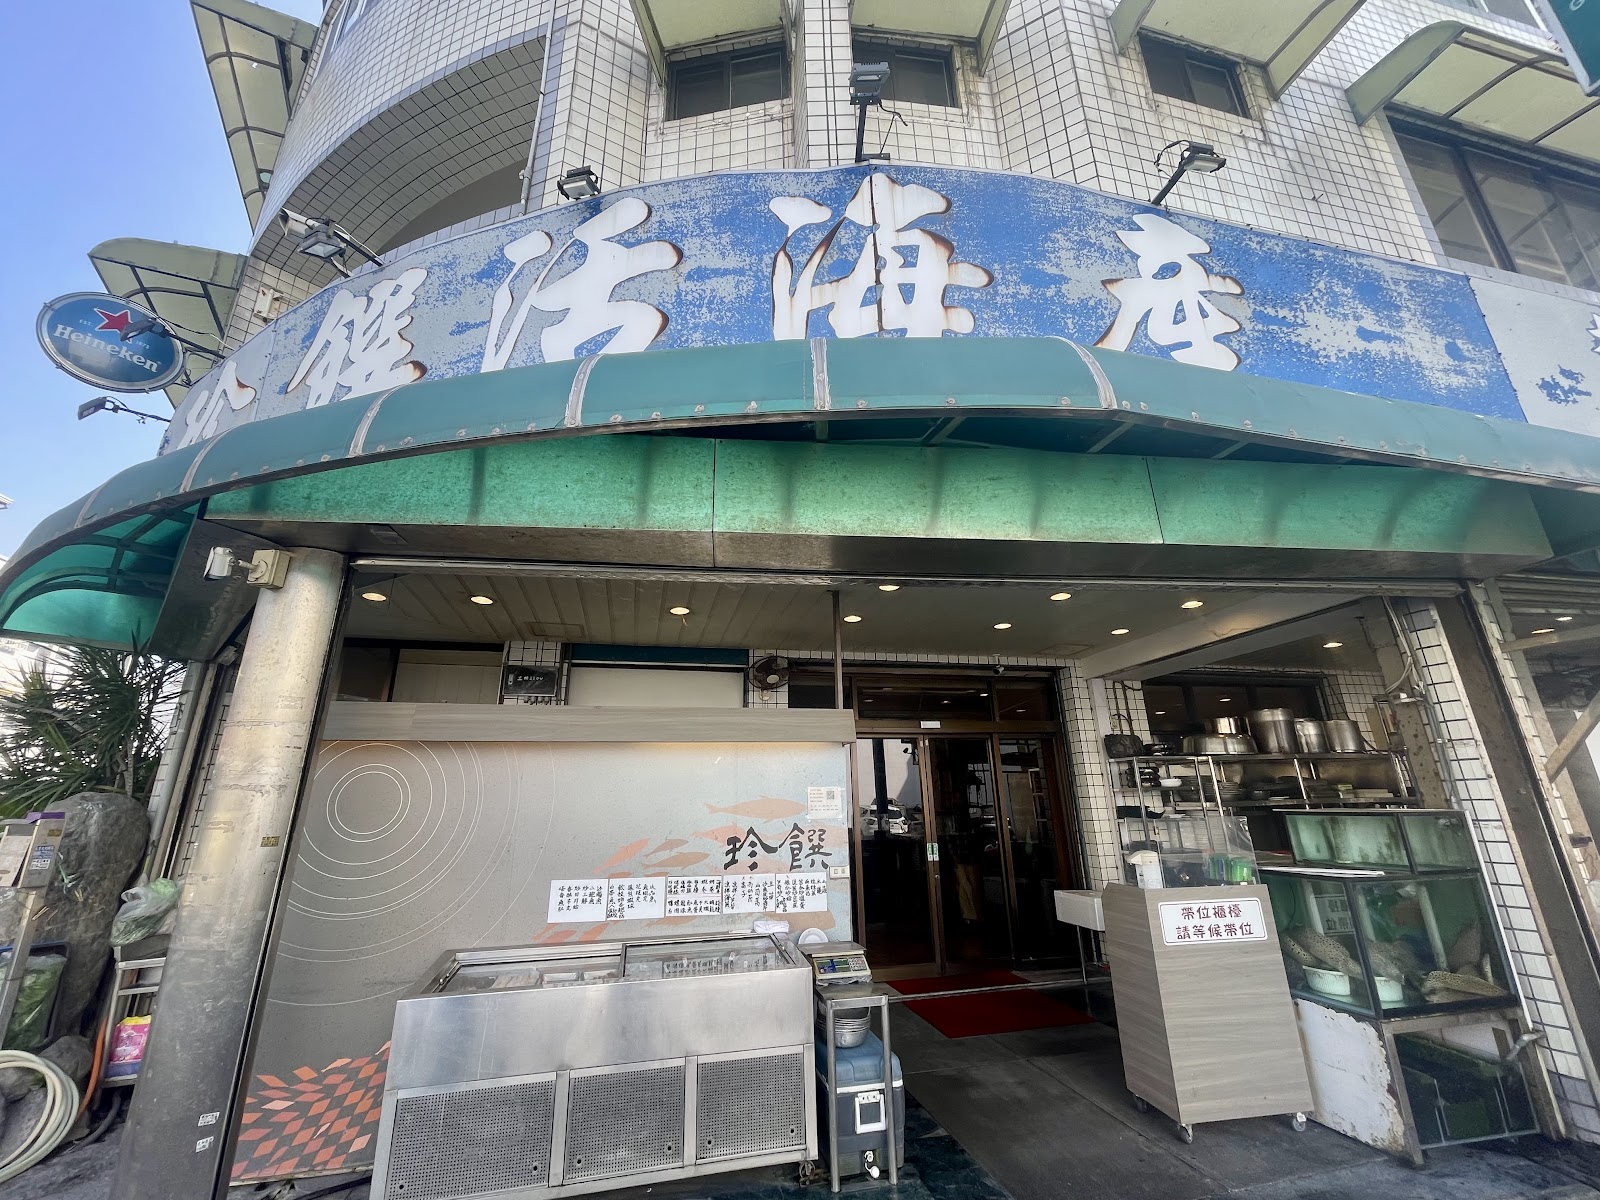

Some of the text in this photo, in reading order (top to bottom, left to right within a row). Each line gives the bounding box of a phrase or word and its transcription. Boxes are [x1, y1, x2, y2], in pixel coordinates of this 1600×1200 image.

[53, 324, 159, 373] Heineken
[1181, 903, 1242, 920] 帶位櫃檯
[1175, 922, 1254, 939] 請等候帶位
